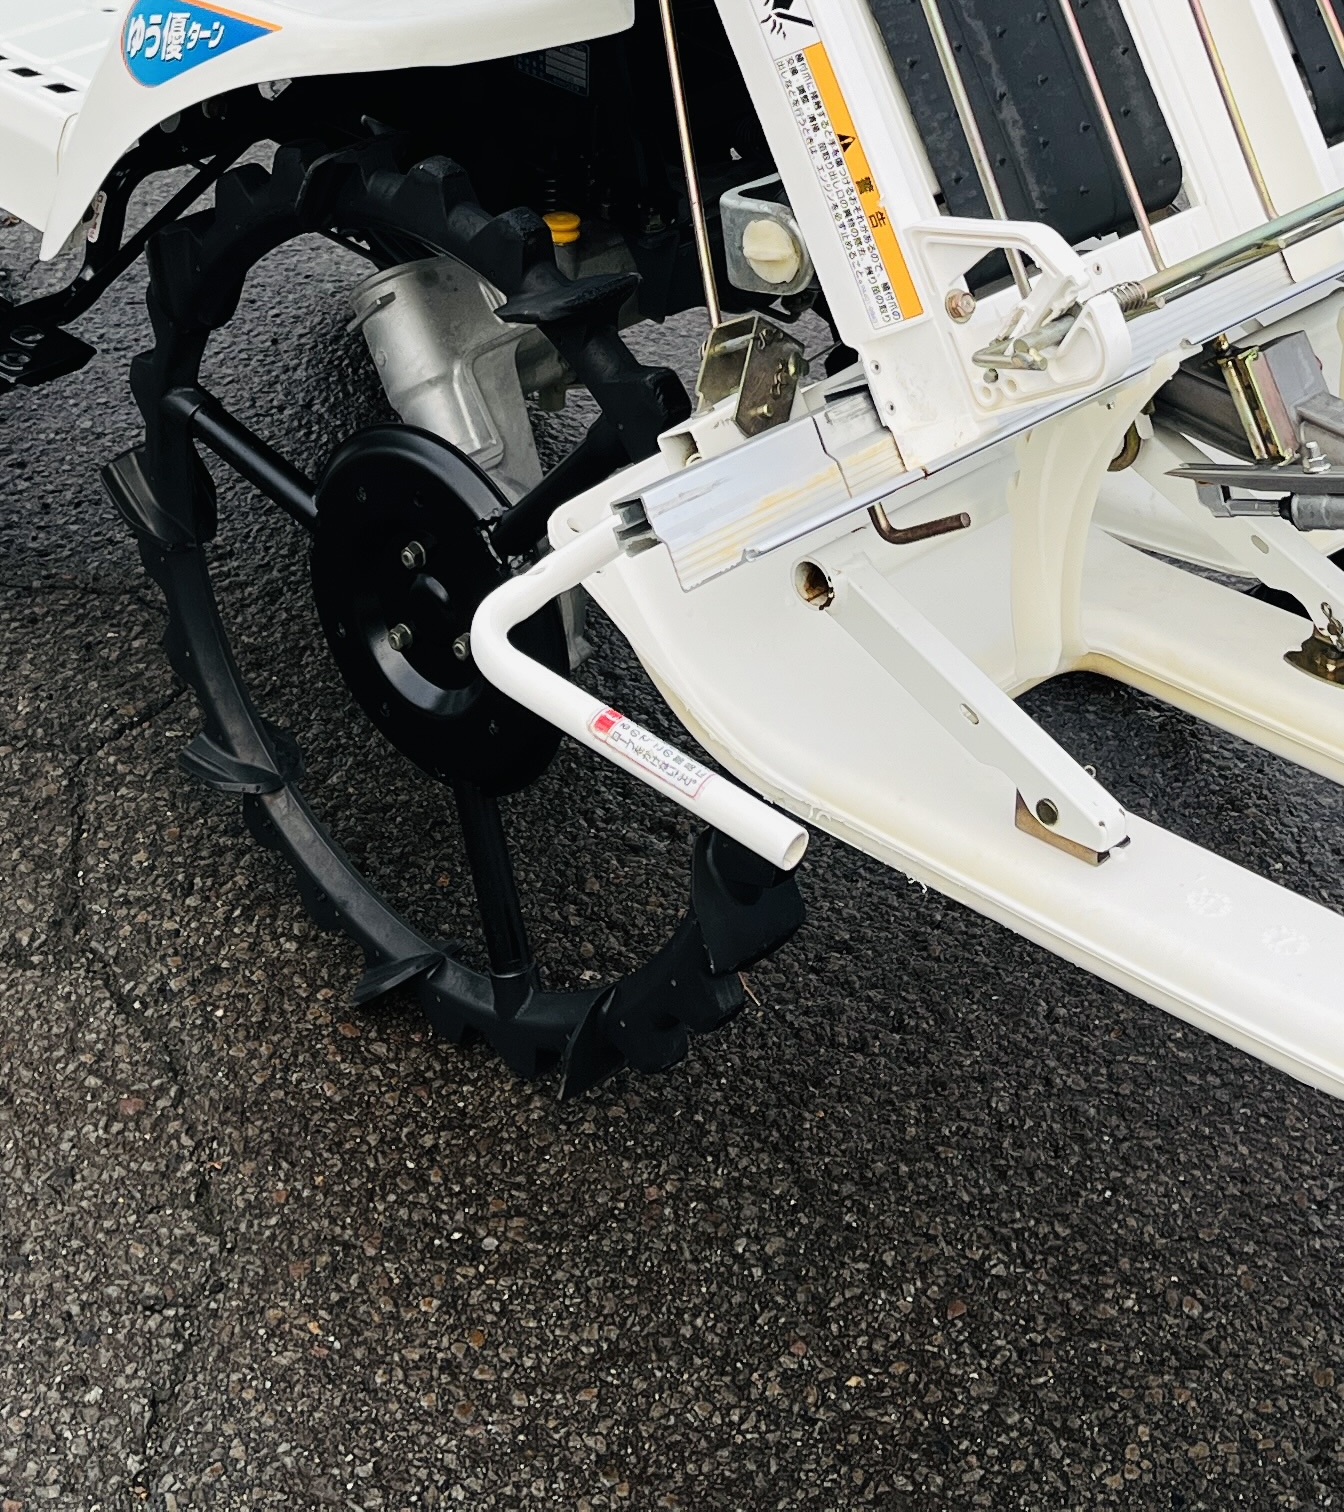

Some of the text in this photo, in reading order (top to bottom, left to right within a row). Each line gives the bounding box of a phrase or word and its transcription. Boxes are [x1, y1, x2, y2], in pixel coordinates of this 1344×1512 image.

[126, 11, 225, 62] ゆう優ターン
